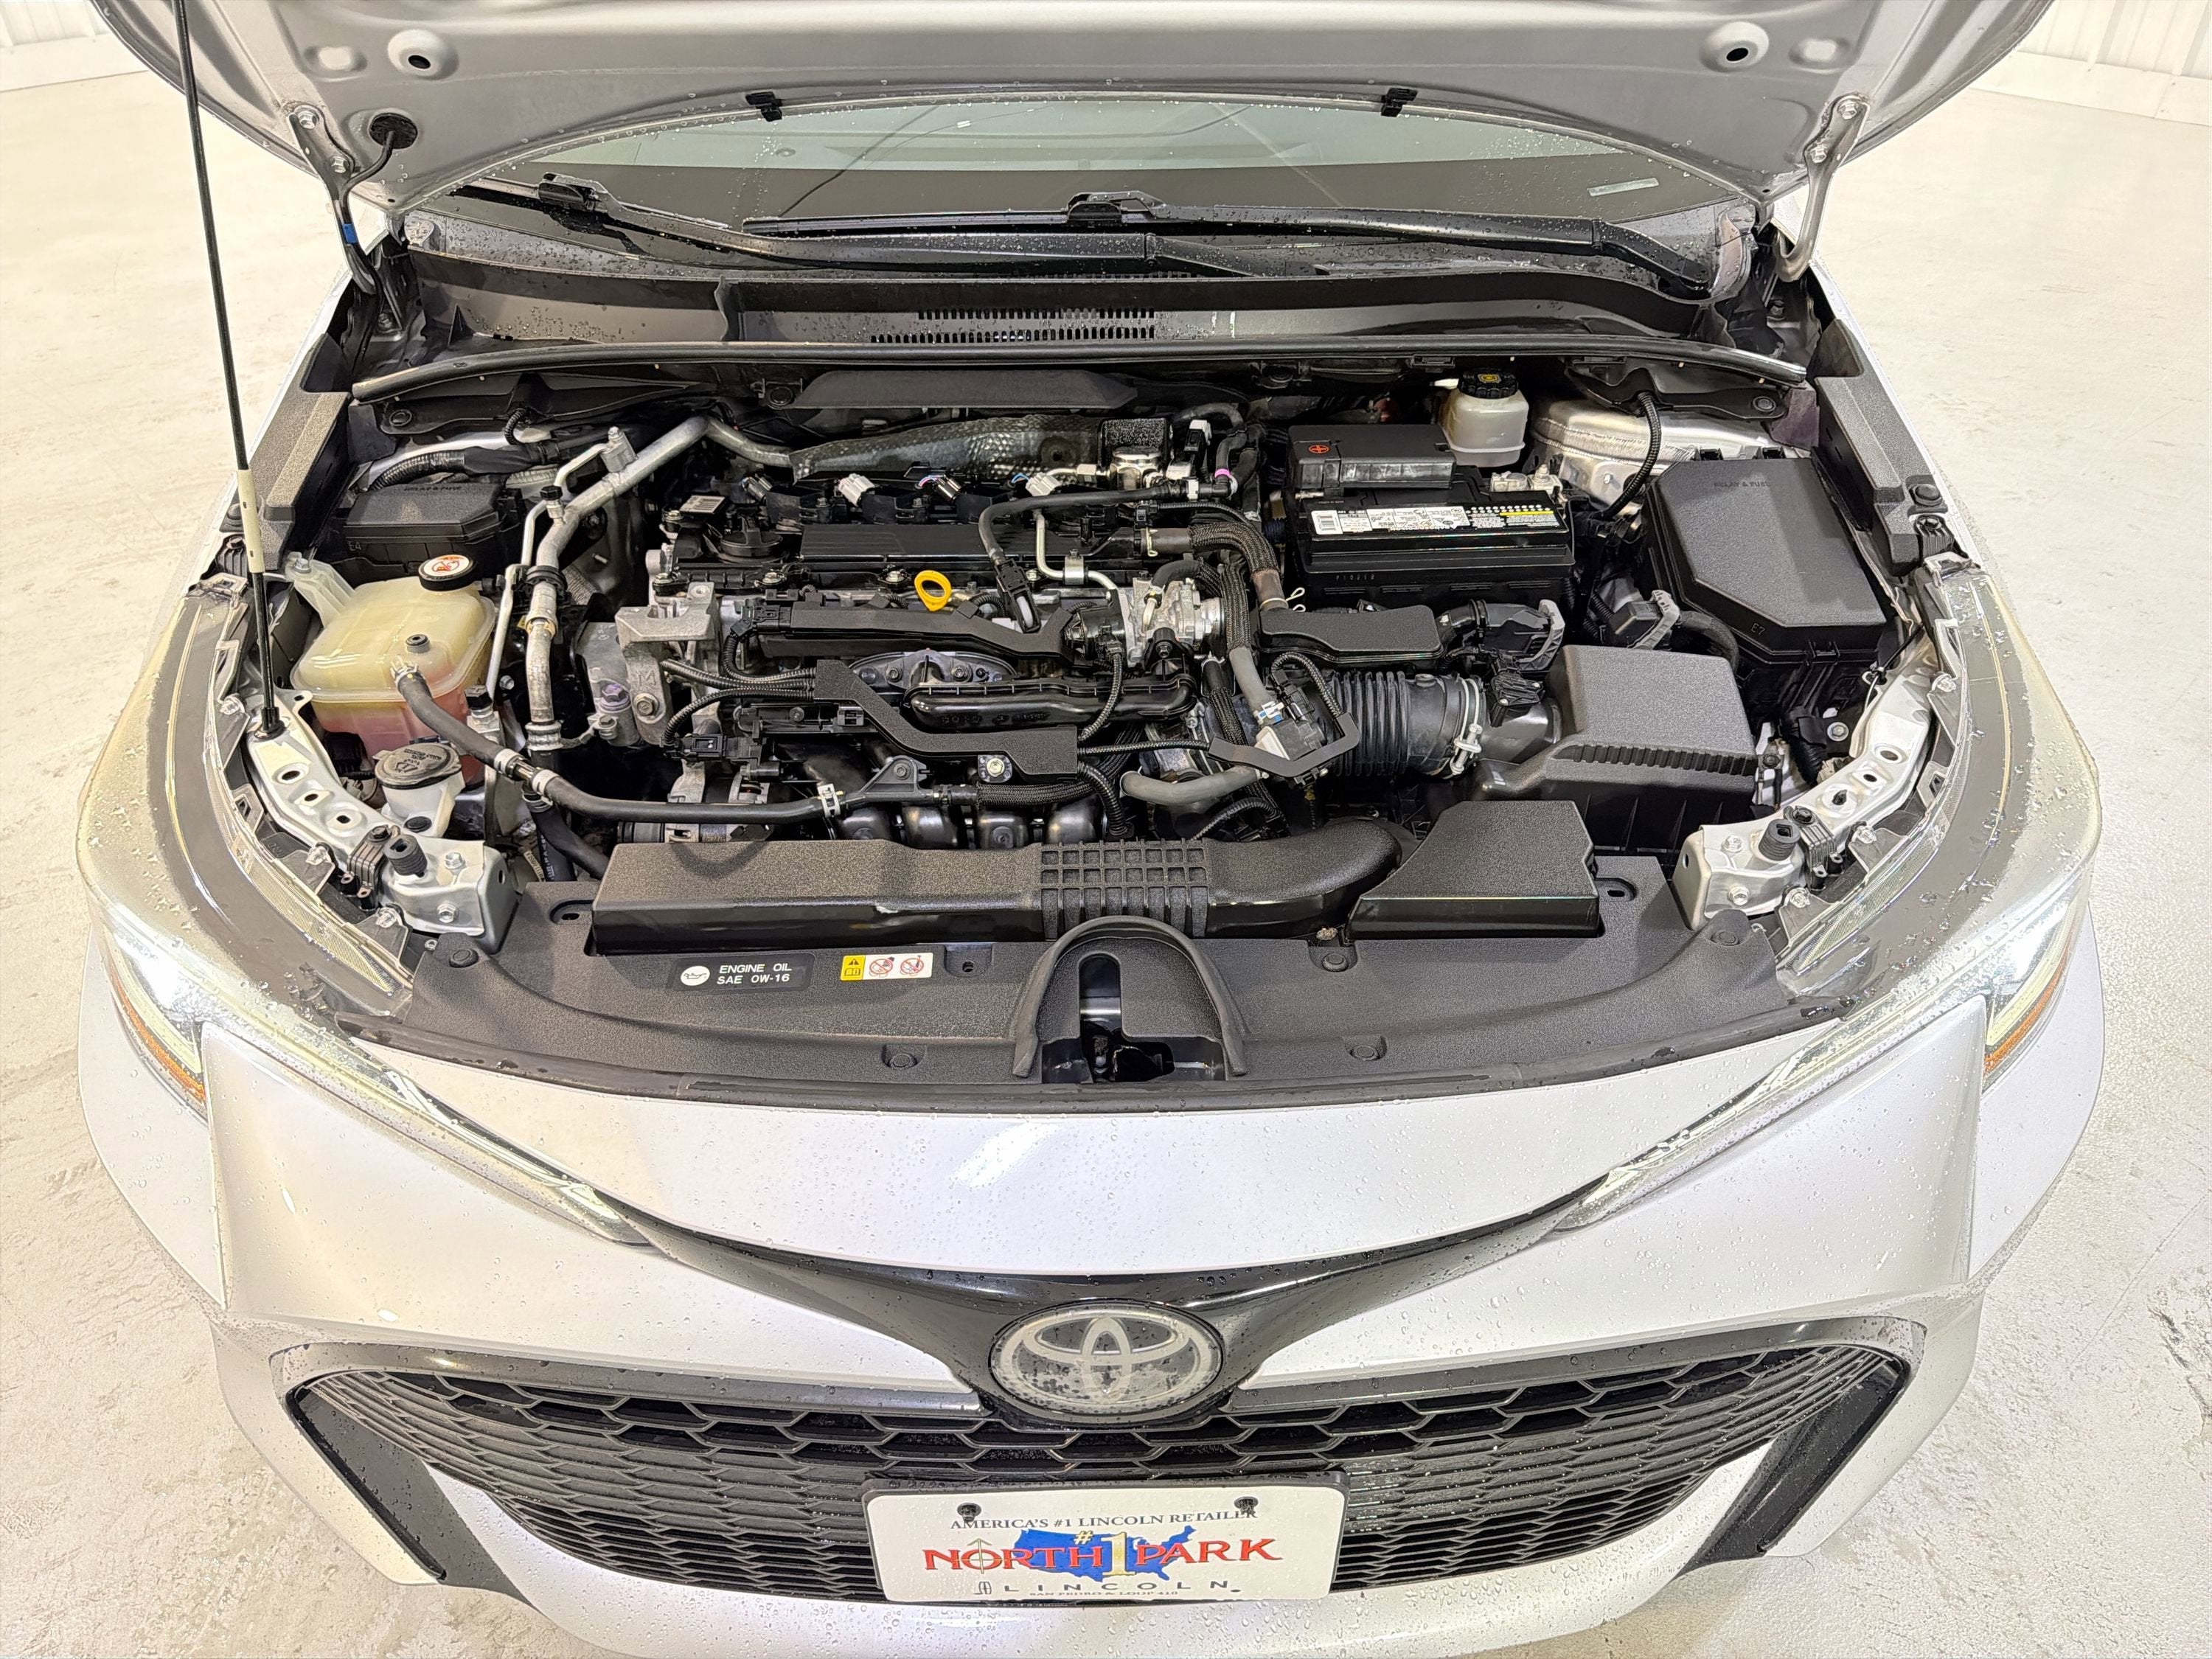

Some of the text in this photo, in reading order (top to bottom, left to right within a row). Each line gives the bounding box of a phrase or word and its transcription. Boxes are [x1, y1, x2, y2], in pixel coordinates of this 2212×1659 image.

[1750, 622, 1766, 636] E7
[719, 962, 793, 974] ENGINE OIL
[717, 973, 790, 985] SAE 0W-16
[1053, 1518, 1073, 1528] #1
[1077, 1514, 1165, 1528] LINCOLN
[922, 1538, 1283, 1571] NORTH PARK
